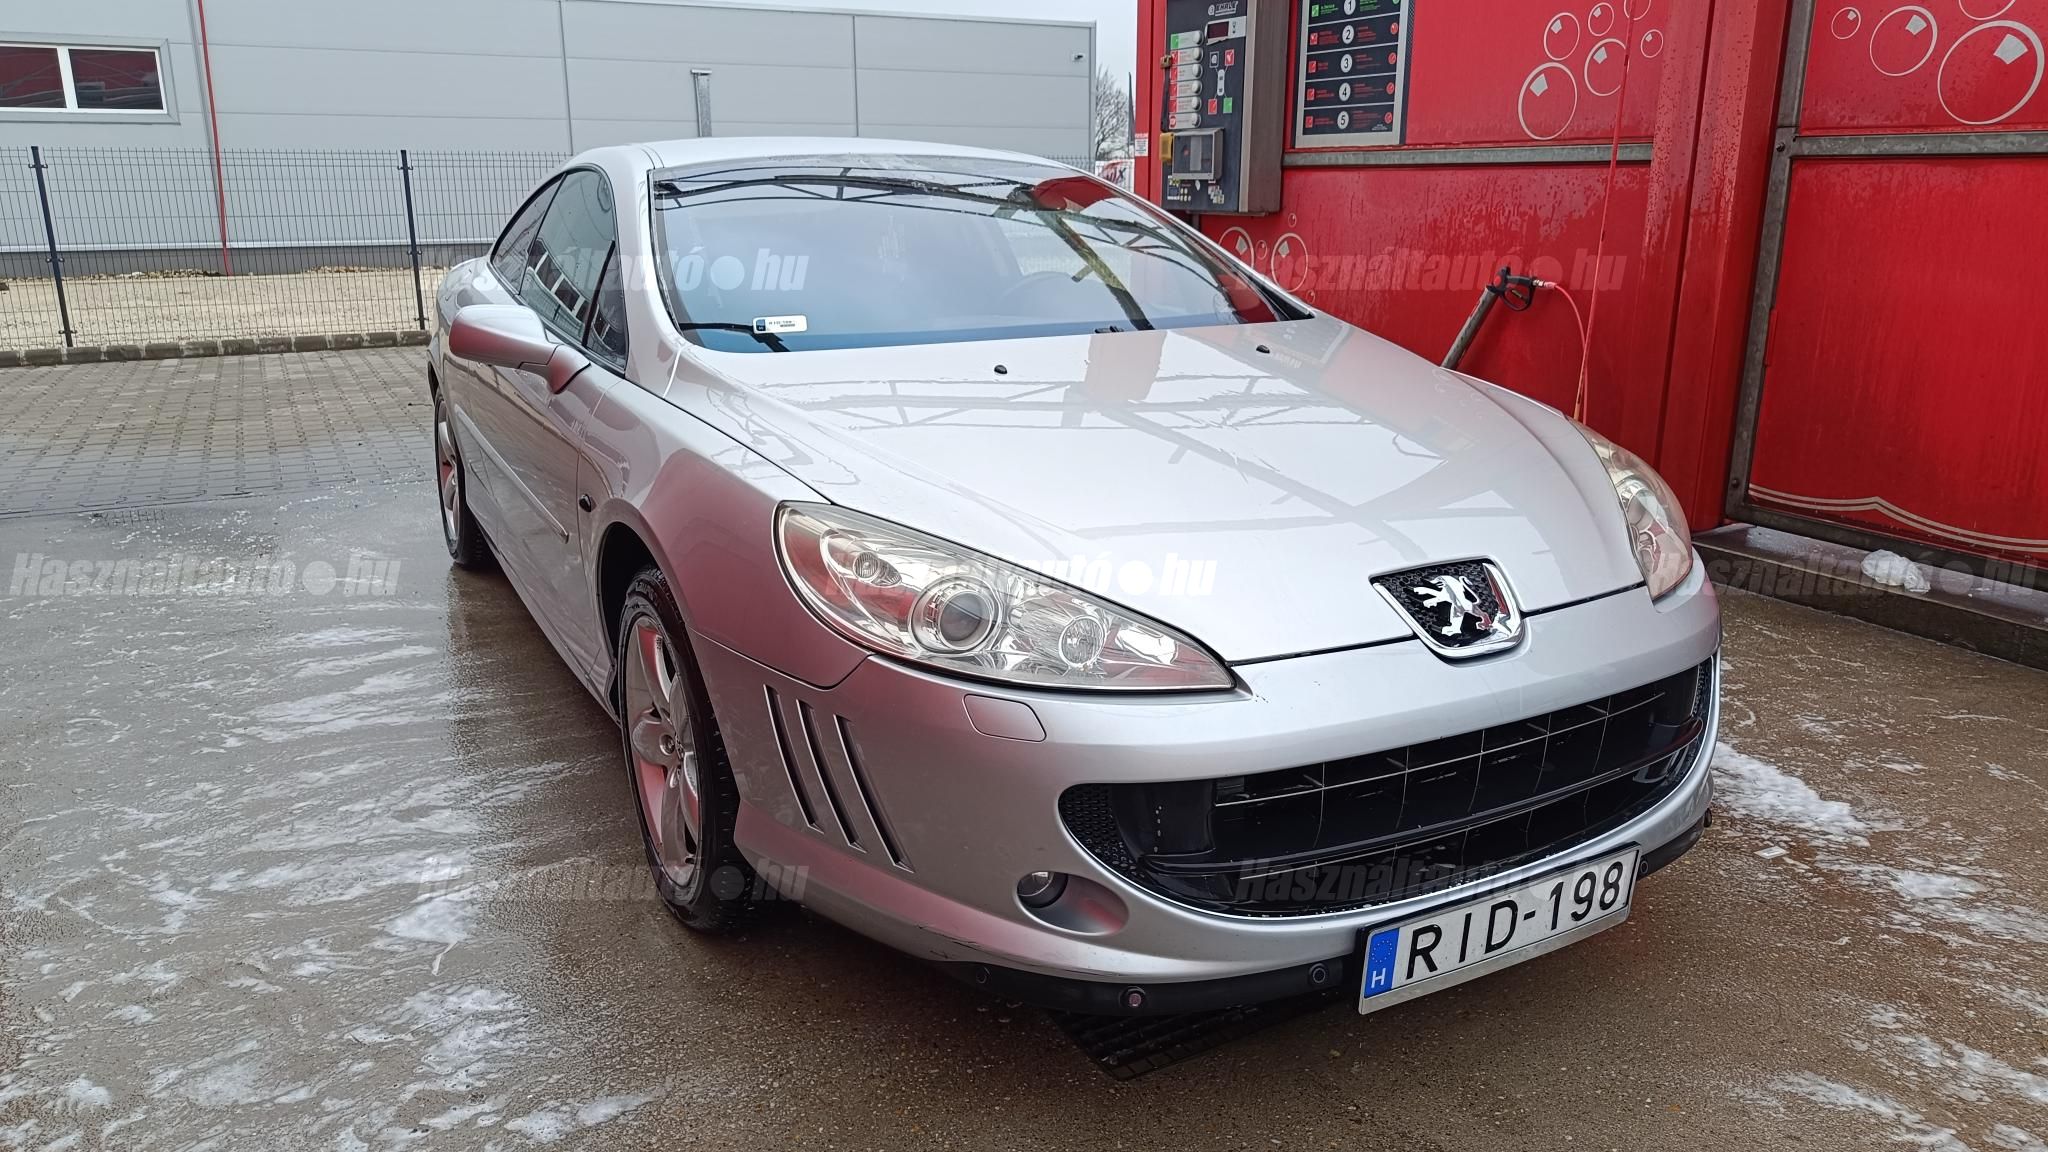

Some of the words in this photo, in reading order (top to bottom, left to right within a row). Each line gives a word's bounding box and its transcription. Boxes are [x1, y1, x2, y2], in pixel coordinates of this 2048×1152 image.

[1346, 30, 1350, 40] 2
[1344, 58, 1349, 68] 3
[1342, 87, 1347, 97] 4
[1341, 115, 1346, 125] 5
[1406, 861, 1624, 980] RID-198
[1370, 967, 1387, 989] H
